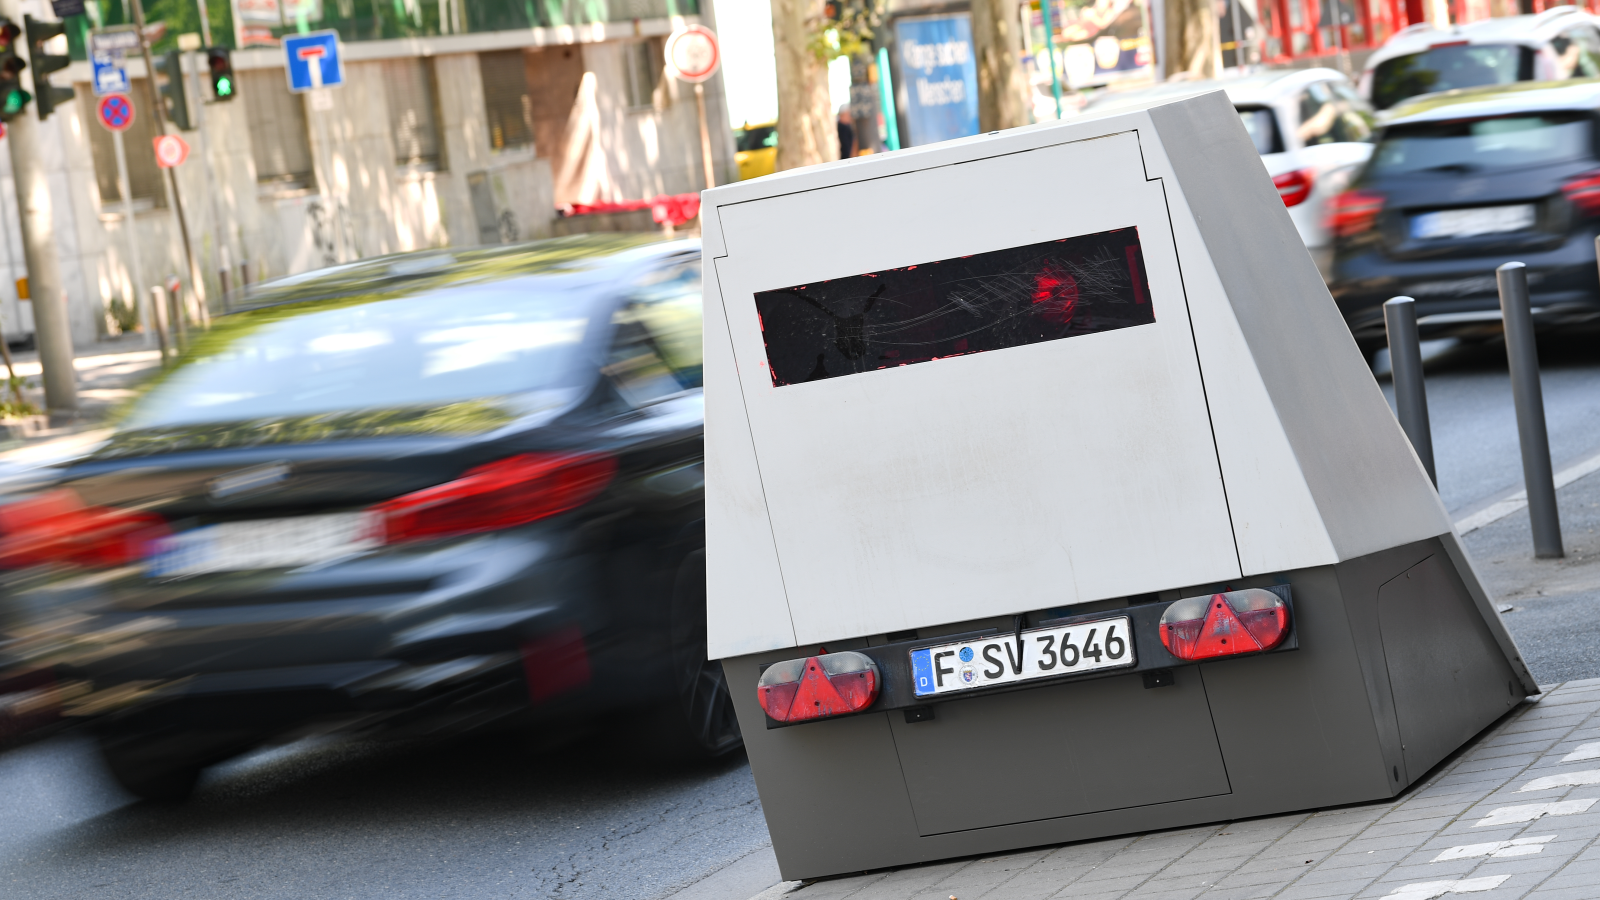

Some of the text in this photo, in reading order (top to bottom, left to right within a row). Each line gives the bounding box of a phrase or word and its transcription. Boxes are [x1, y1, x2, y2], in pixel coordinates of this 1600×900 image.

[934, 650, 955, 687] F
[982, 640, 1025, 679] SV
[1036, 625, 1125, 671] 3646
[920, 677, 928, 687] D
